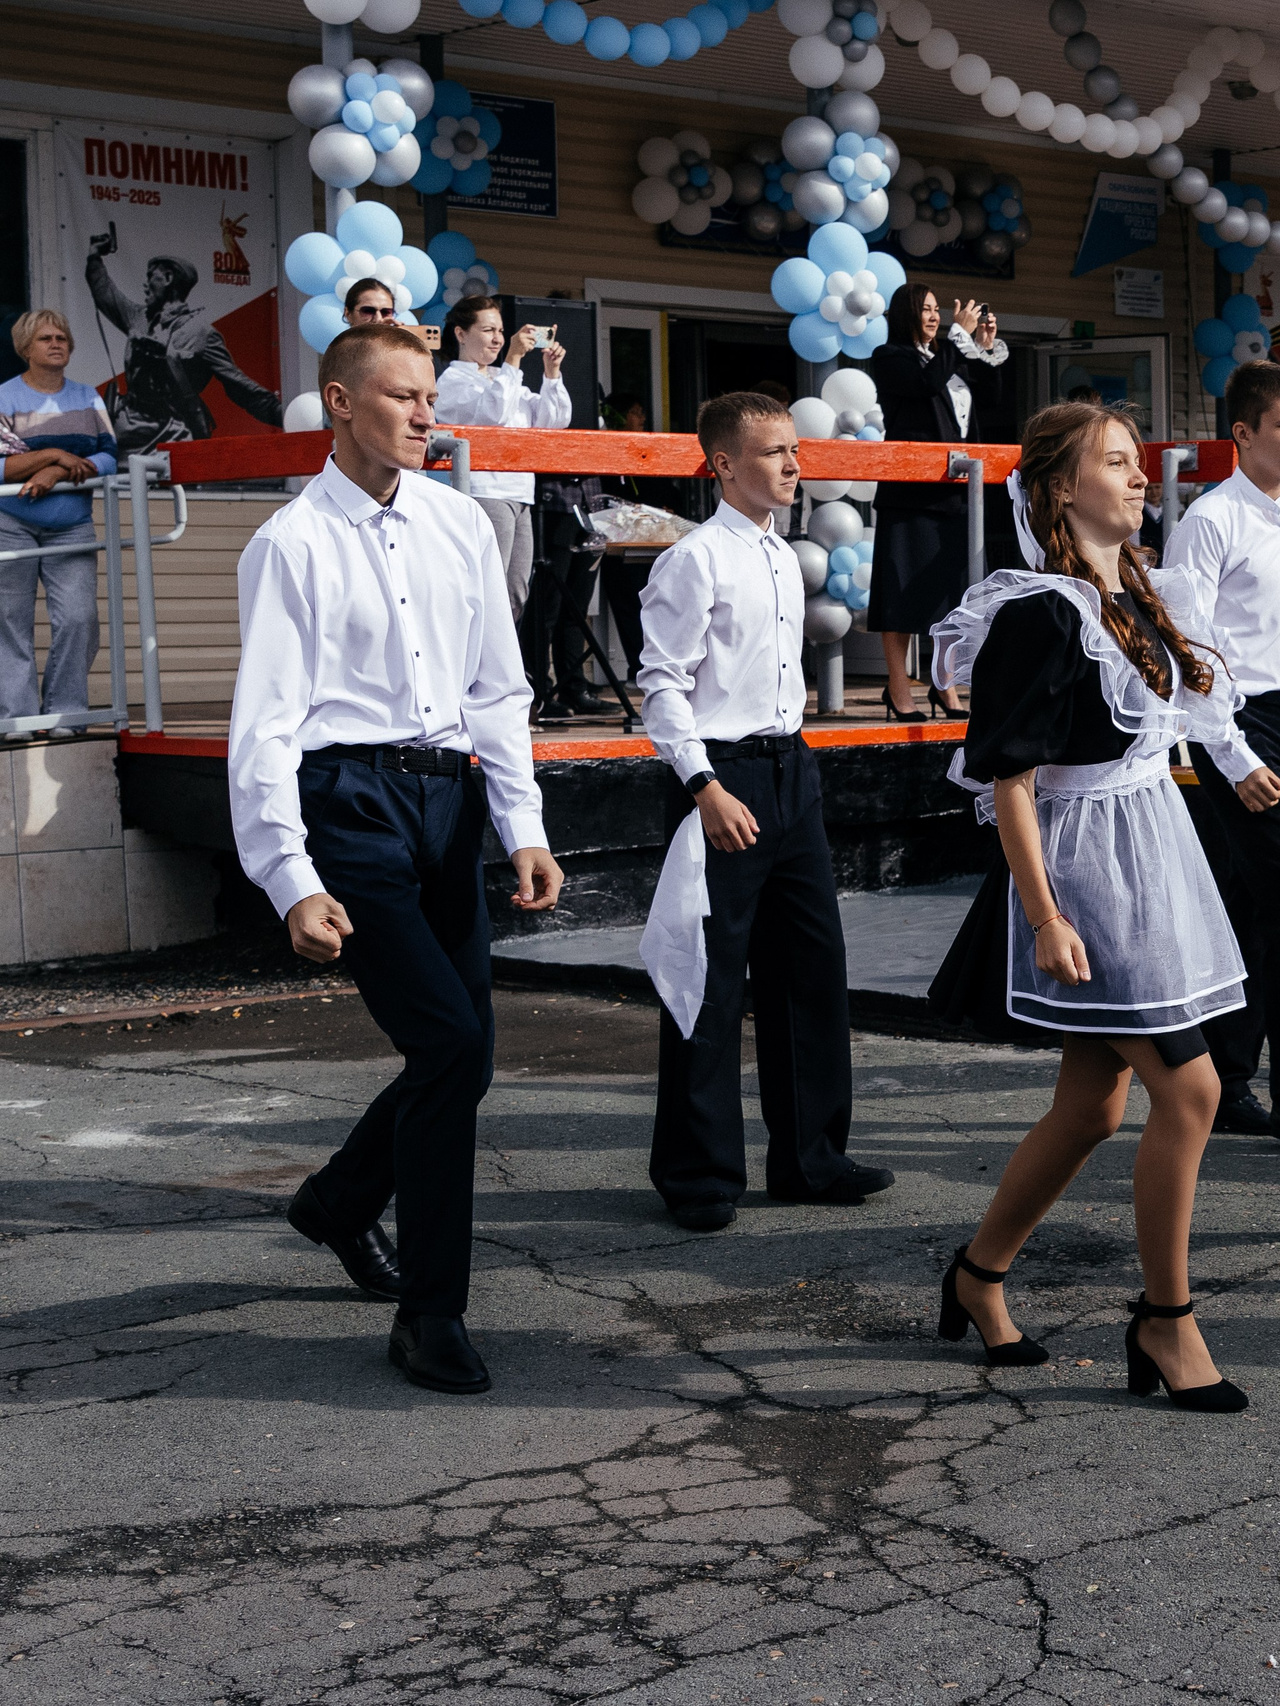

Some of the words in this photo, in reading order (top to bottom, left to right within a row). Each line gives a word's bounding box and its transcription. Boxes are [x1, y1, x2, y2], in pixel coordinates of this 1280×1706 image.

[84, 138, 249, 192] ПОМНИМ!
[500, 153, 540, 166] бюджетное
[510, 167, 552, 180] учреждение
[213, 251, 233, 270] 80
